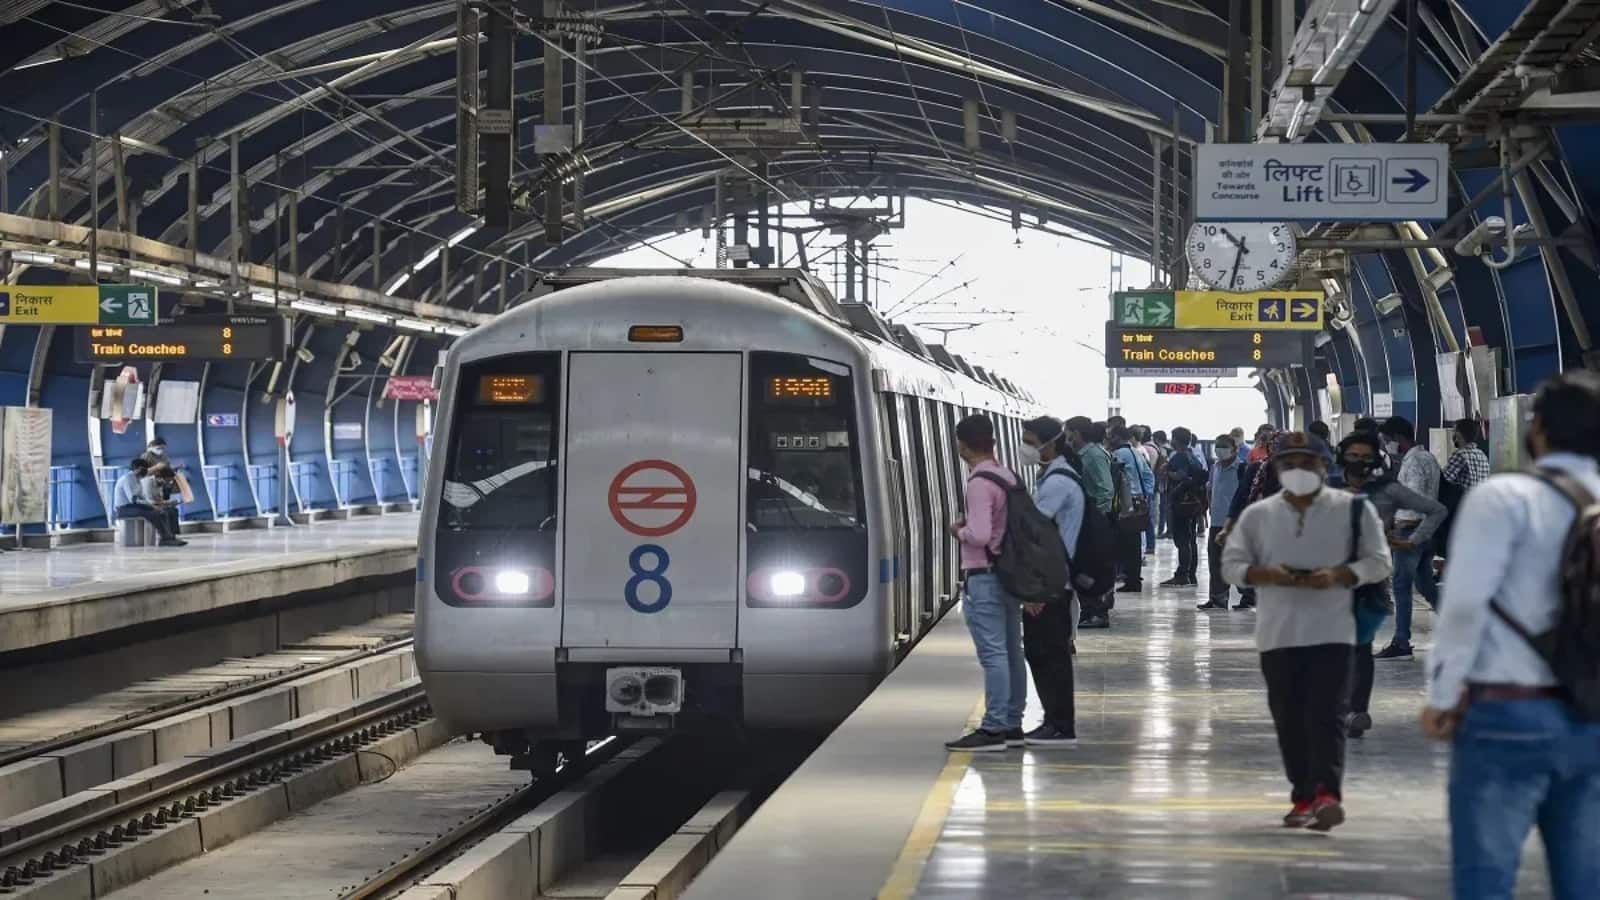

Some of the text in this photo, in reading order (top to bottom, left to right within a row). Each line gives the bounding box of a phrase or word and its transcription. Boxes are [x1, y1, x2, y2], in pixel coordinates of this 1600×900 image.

[1263, 157, 1325, 182] लिफ्ट
[1216, 182, 1256, 190] Towards
[1211, 191, 1260, 200] Concourse
[1283, 185, 1325, 203] Lift
[1203, 225, 1217, 236] 10
[1272, 226, 1281, 236] 2
[1196, 242, 1205, 252] 9
[1277, 242, 1286, 252] 3
[1203, 258, 1211, 268] 8
[1269, 259, 1278, 268] 4
[1217, 270, 1227, 280] 7
[1236, 275, 1244, 285] 6
[1256, 270, 1265, 280] 5
[15, 293, 54, 305] निकास
[1216, 298, 1255, 311] निकास
[15, 306, 39, 316] Exit
[1230, 312, 1255, 321] Exit
[222, 327, 232, 338] 8
[1252, 333, 1262, 344] 8
[91, 343, 232, 354] Train Coaches 8
[1121, 349, 1262, 360] Train Coaches 8
[1163, 383, 1196, 393] 10:32
[624, 543, 673, 614] 8
